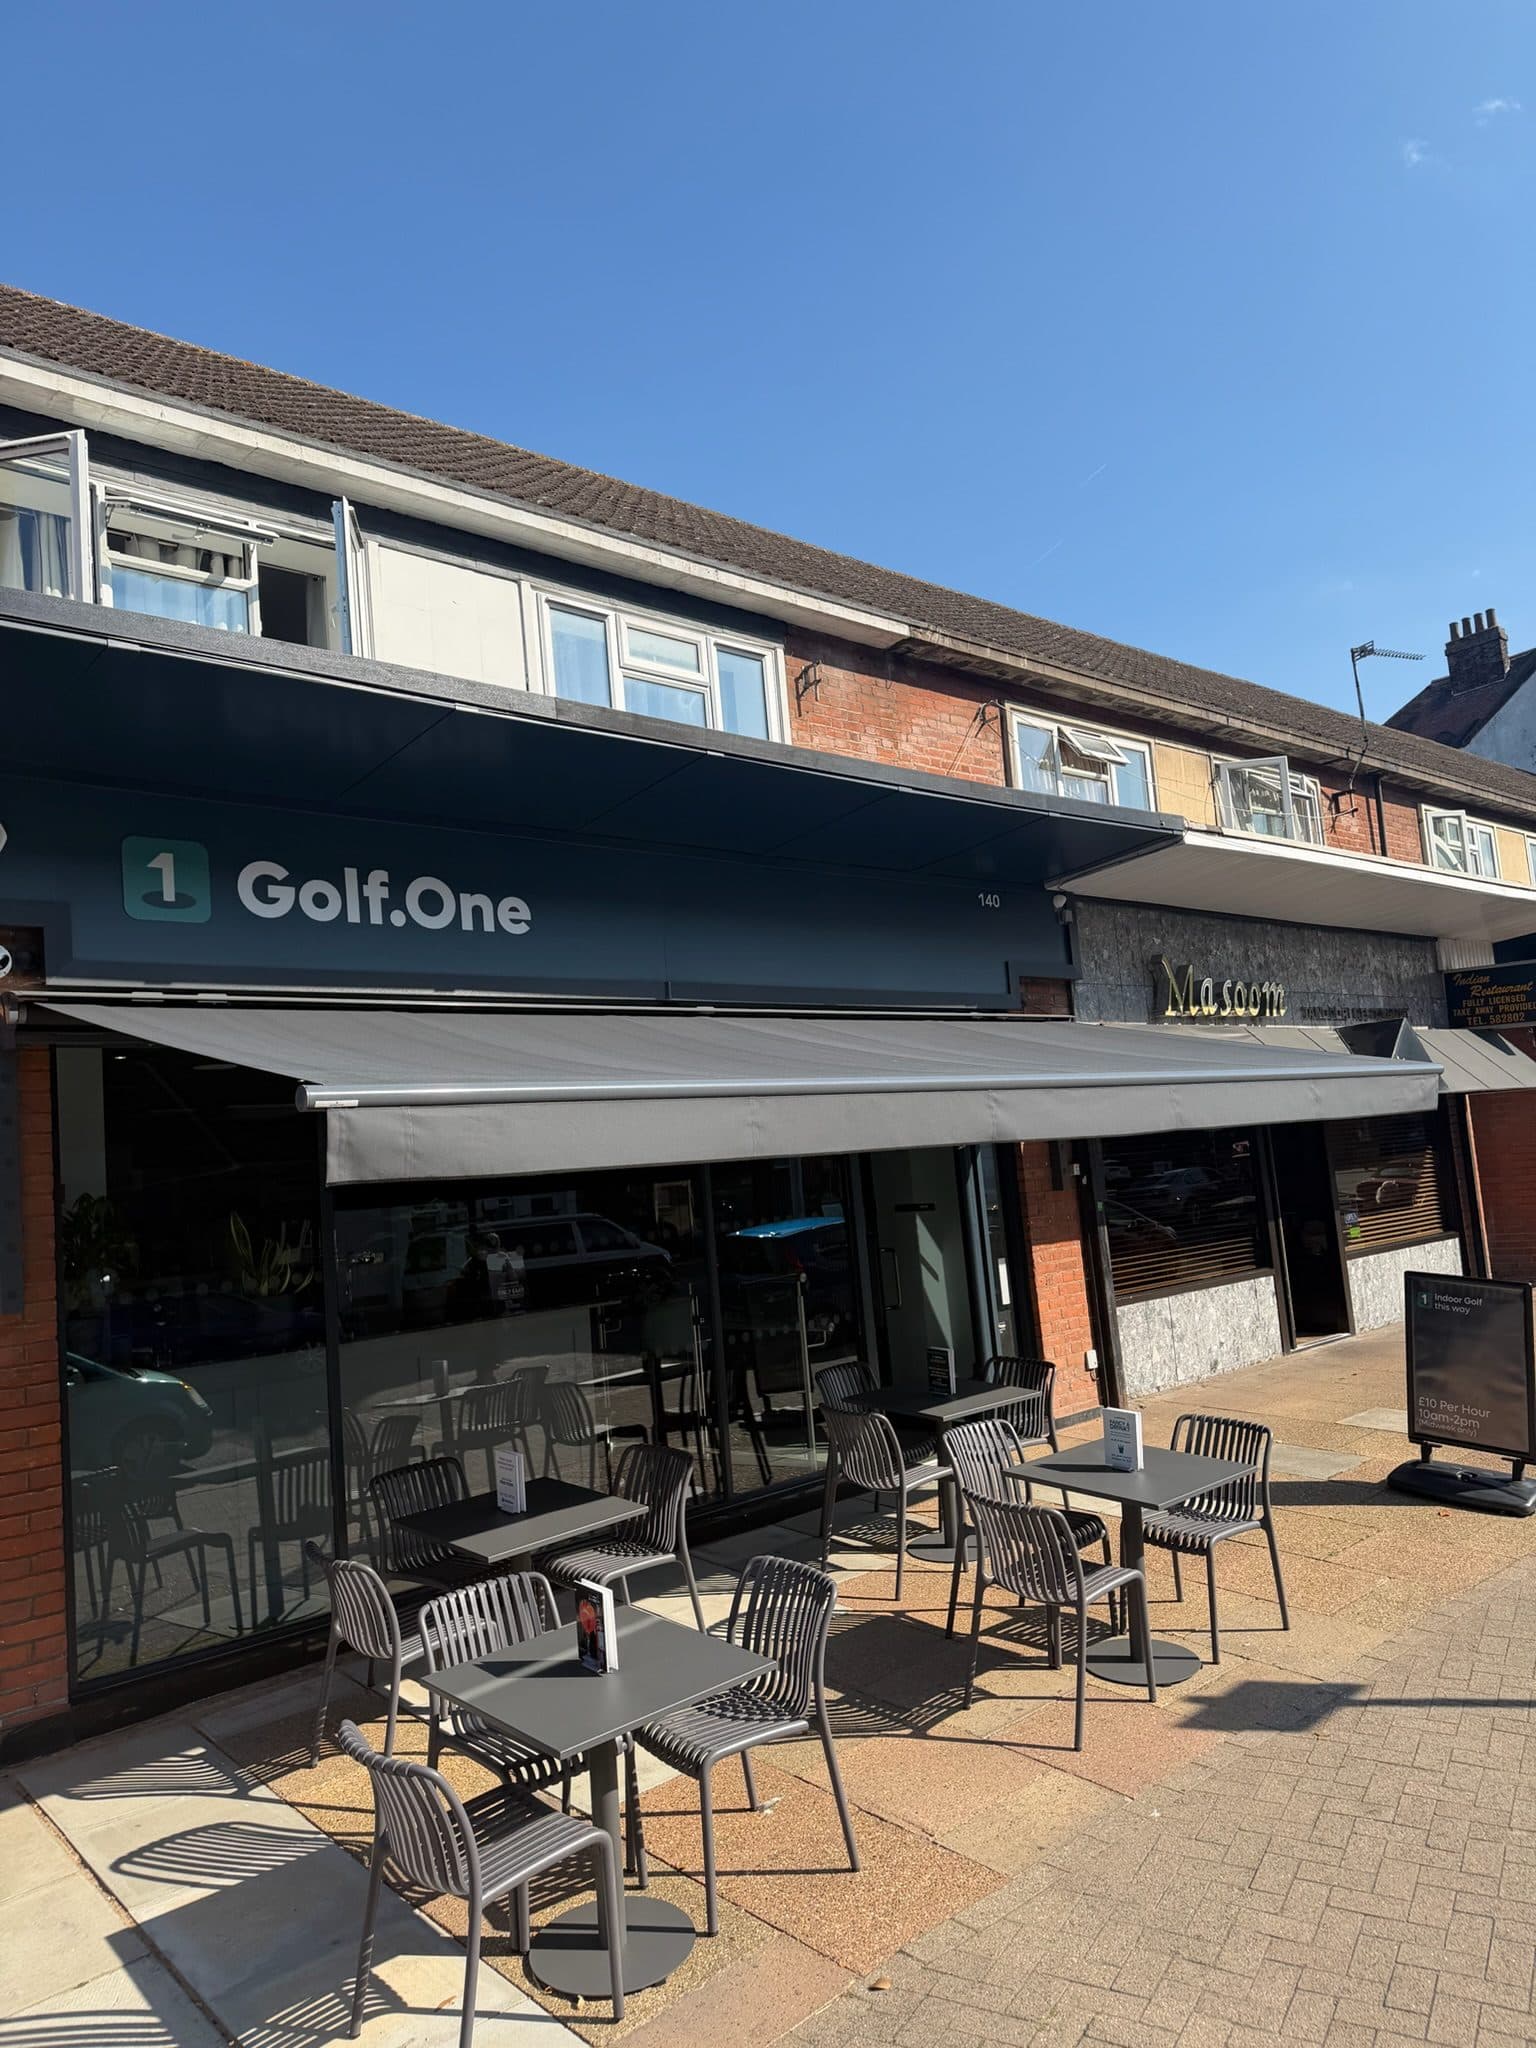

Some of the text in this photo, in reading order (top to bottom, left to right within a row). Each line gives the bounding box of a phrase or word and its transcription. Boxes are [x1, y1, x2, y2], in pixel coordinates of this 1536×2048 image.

[146, 852, 532, 935] 1 Golf.One
[978, 893, 1000, 908] 140
[1161, 953, 1287, 1016] Masoom
[1454, 974, 1490, 985] Indian
[1471, 981, 1534, 998] Restaurant
[1463, 994, 1526, 1007] FULLY LICENSED
[1454, 1008, 1472, 1017] TAKE
[1475, 1005, 1494, 1015] AWAY
[1489, 1012, 1525, 1023] 582802
[1434, 1293, 1483, 1306] Indoor Golf
[1434, 1302, 1470, 1315] this way
[1418, 1396, 1491, 1418] £10 Per Hour
